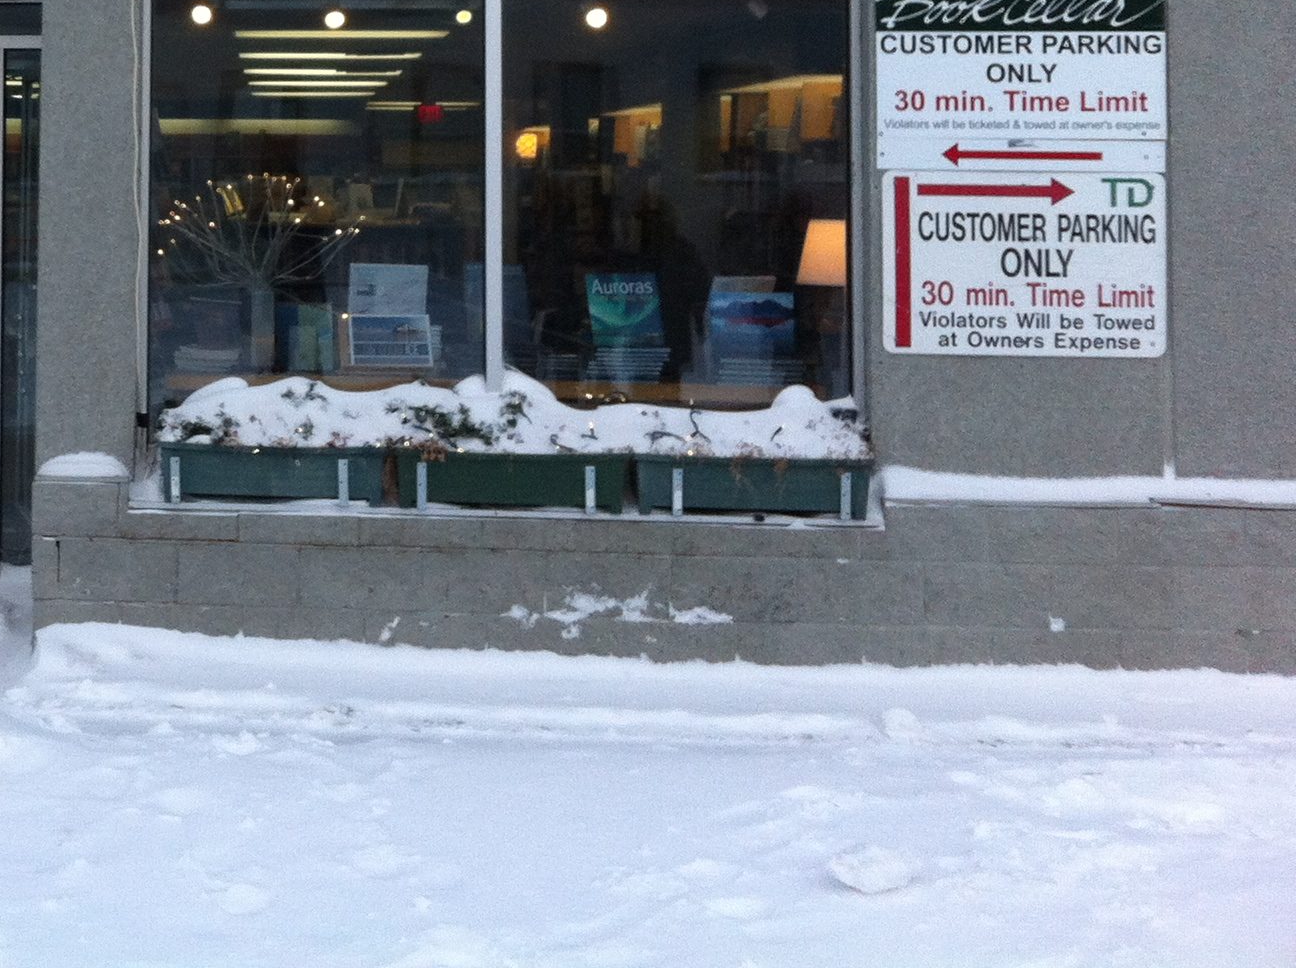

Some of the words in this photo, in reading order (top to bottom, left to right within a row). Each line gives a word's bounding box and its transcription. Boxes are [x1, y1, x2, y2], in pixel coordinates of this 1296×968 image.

[880, 34, 1033, 55] CUSTOMER
[1042, 34, 1162, 55] PARKING
[986, 62, 1057, 83] ONLY
[894, 90, 926, 113] 30
[935, 90, 993, 113] min.
[1003, 90, 1070, 113] Time
[1080, 90, 1149, 113] Limit
[884, 118, 930, 130] Violators
[932, 119, 951, 130] will
[952, 119, 966, 130] be
[968, 119, 1010, 130] ticketed
[1012, 119, 1021, 130] &
[1023, 119, 1056, 130] towed
[1058, 120, 1070, 130] at
[1071, 119, 1113, 130] owner's
[1115, 121, 1161, 132] expense
[1101, 177, 1155, 207] TD
[918, 211, 1047, 243] CUSTOMER
[1057, 214, 1157, 244] PARKING
[1000, 248, 1074, 278] ONLY
[591, 279, 654, 294] Auroras
[921, 280, 954, 306] 30
[966, 281, 1015, 307] min.
[1027, 282, 1085, 308] Time
[1097, 283, 1155, 308] Limit
[919, 311, 1008, 329] Violators
[1016, 312, 1051, 330] Will
[1060, 312, 1084, 330] be
[1093, 313, 1155, 331] Towed
[938, 333, 957, 348] at
[968, 332, 1044, 349] Owners
[1054, 334, 1142, 352] Expense
